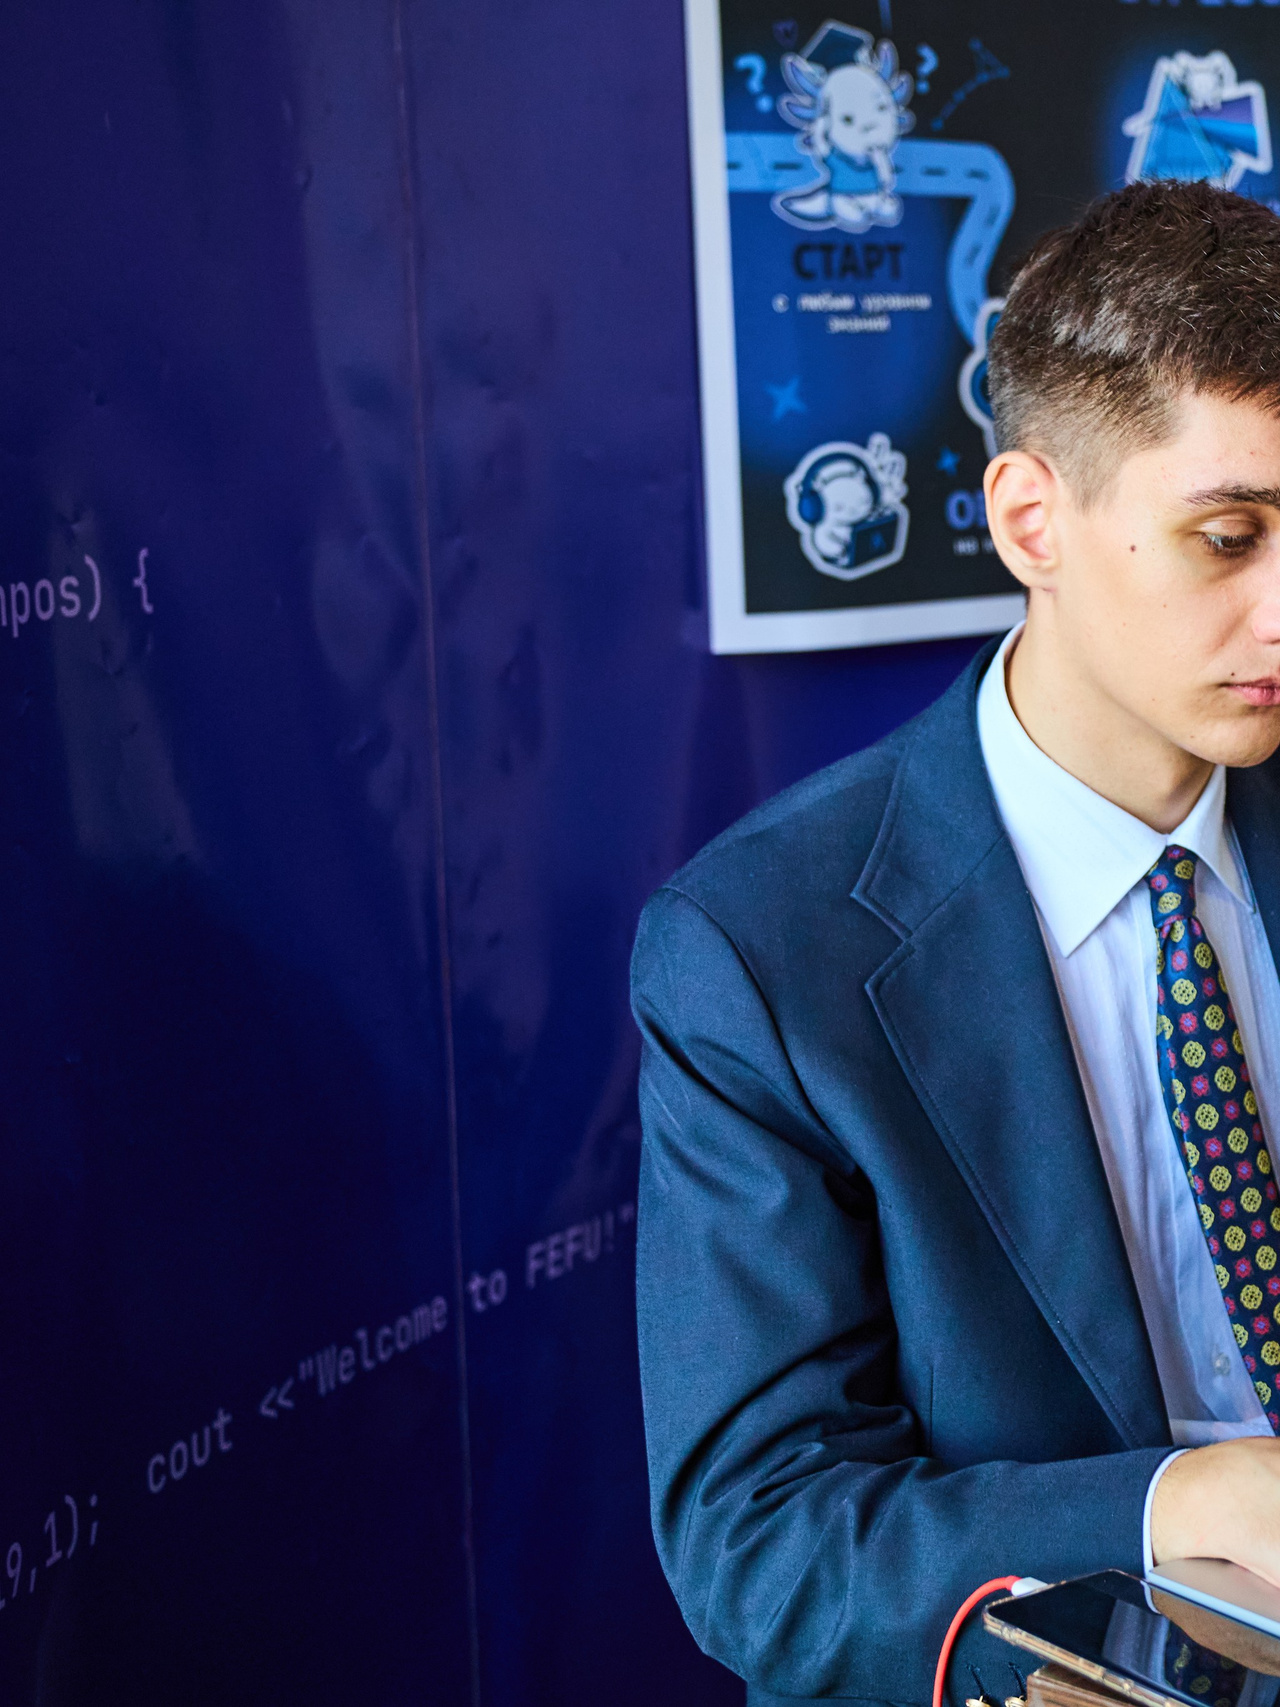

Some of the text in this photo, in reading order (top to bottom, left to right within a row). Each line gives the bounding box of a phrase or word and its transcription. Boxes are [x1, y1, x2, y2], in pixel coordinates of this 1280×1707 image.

[793, 243, 903, 280] СТАРТ
[147, 1407, 233, 1494] cout
[466, 1269, 507, 1313] to
